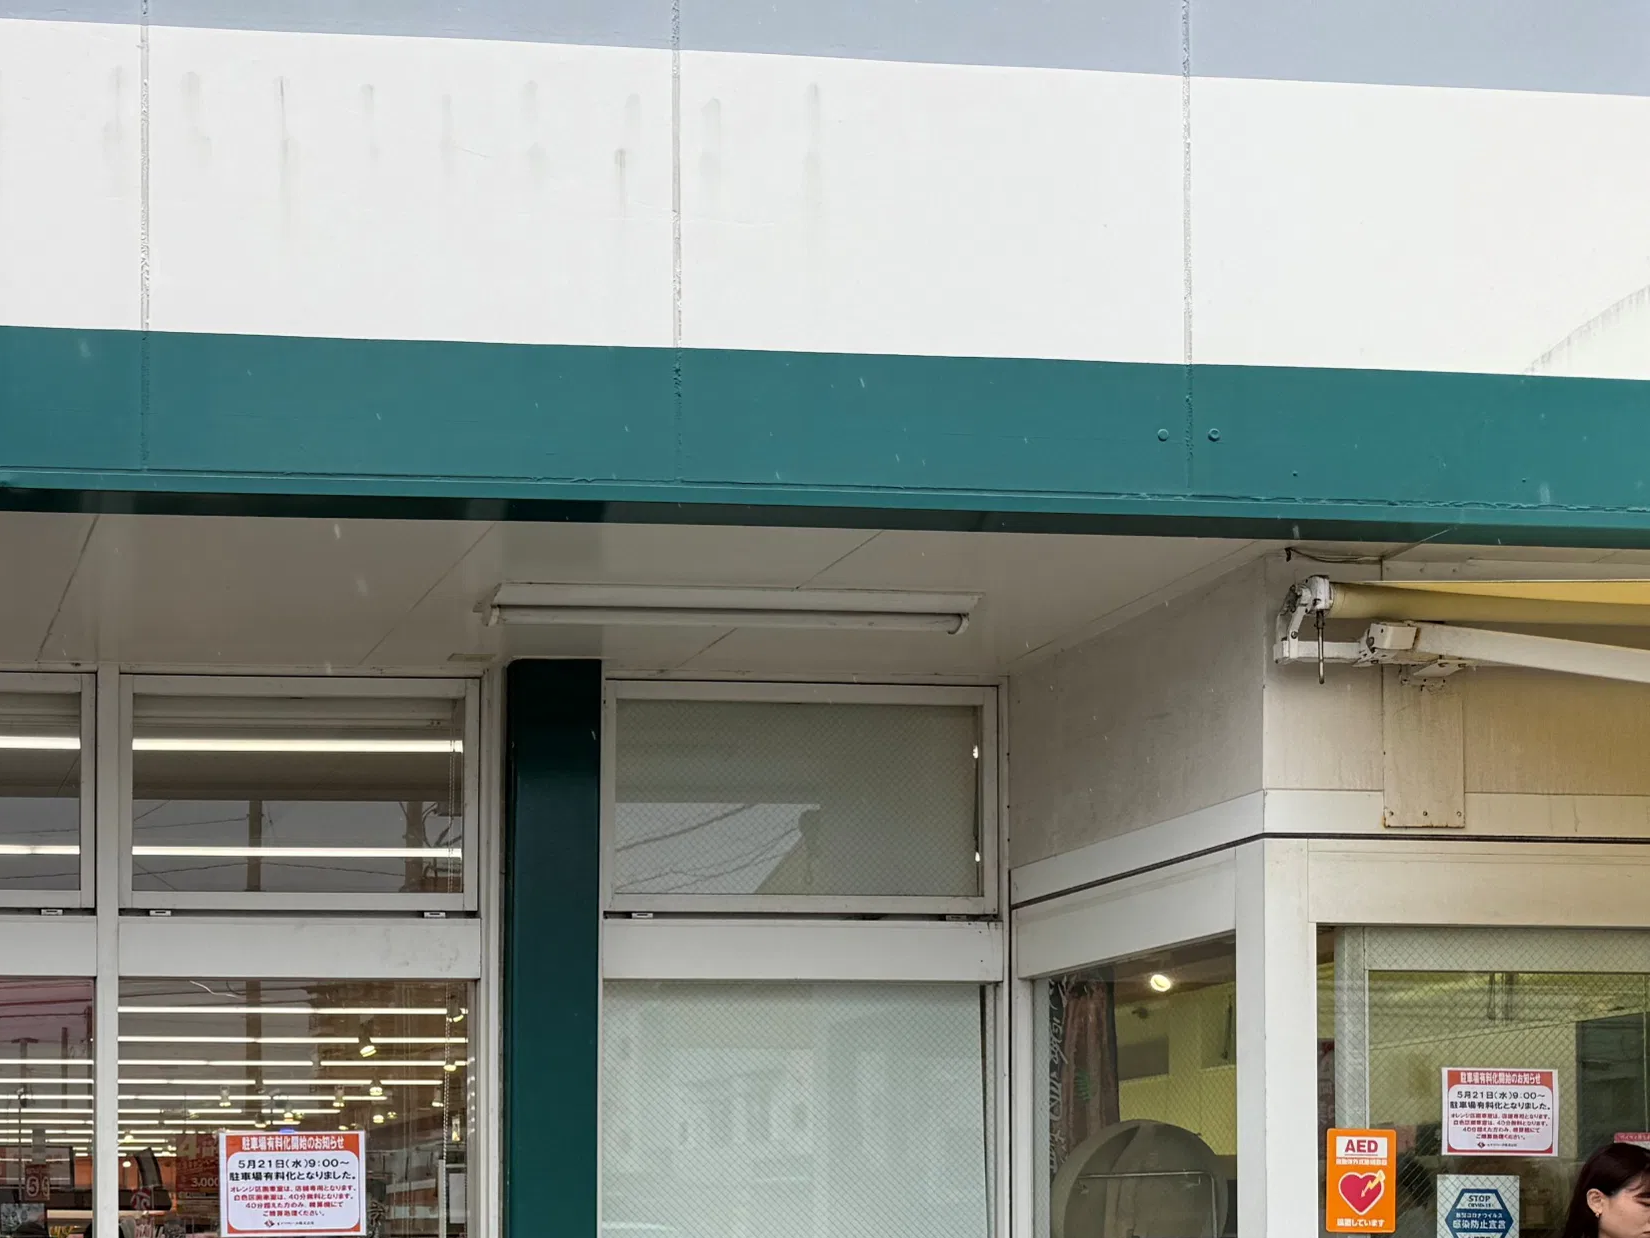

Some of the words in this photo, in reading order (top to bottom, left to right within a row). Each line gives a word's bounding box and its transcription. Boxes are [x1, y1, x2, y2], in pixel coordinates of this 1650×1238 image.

[241, 1136, 345, 1151] 駐車場有料化開始のお知らせ
[1344, 1139, 1378, 1153] AED
[229, 1171, 356, 1181] 駐車場有料化となりました。
[1468, 1194, 1490, 1202] STOP
[1452, 1219, 1506, 1229] 感染防止宣言
